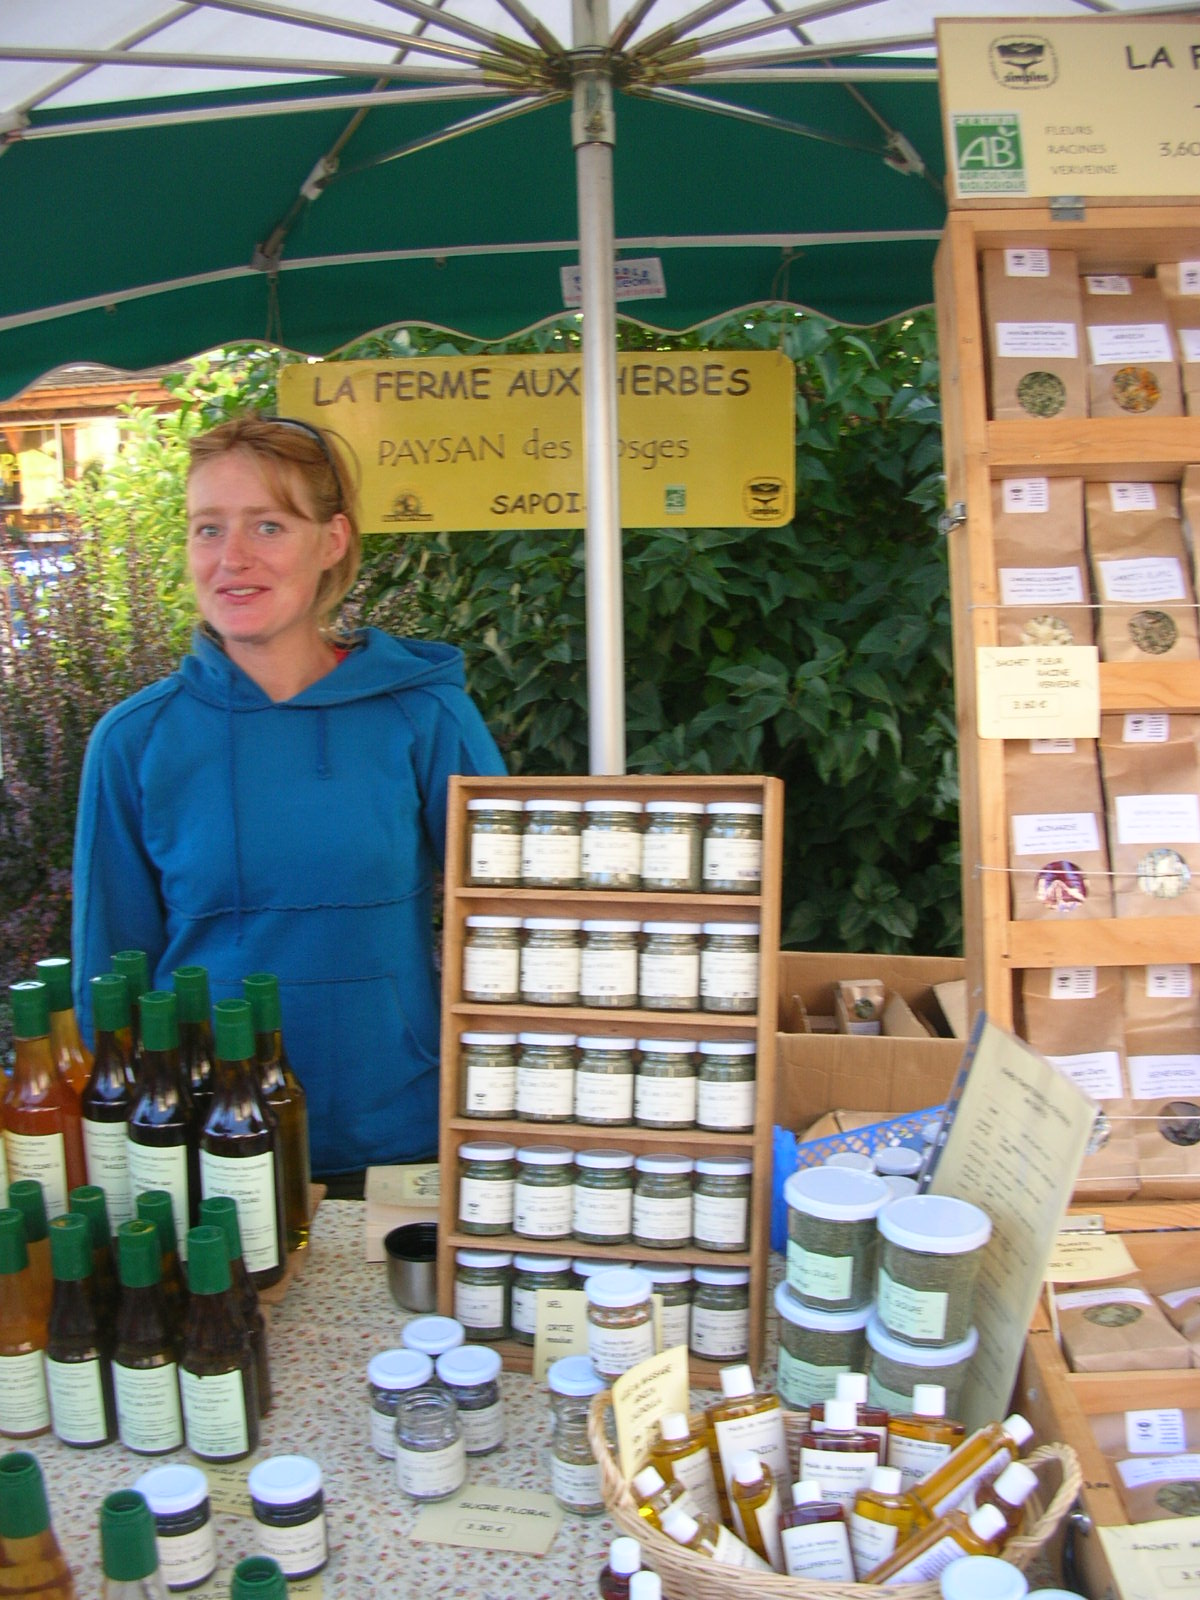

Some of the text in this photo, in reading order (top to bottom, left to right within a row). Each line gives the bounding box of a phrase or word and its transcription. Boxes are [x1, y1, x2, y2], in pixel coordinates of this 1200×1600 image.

[1126, 45, 1174, 70] LA
[1045, 126, 1094, 136] FLEURS
[959, 136, 1017, 168] AB
[314, 376, 356, 406] LA
[375, 368, 492, 402] FERME
[508, 367, 581, 399] AUX
[378, 434, 505, 467] PAYSAN
[523, 428, 572, 460] des
[490, 492, 582, 515] SAPOI
[459, 1502, 552, 1518] SUCRE FLORAL
